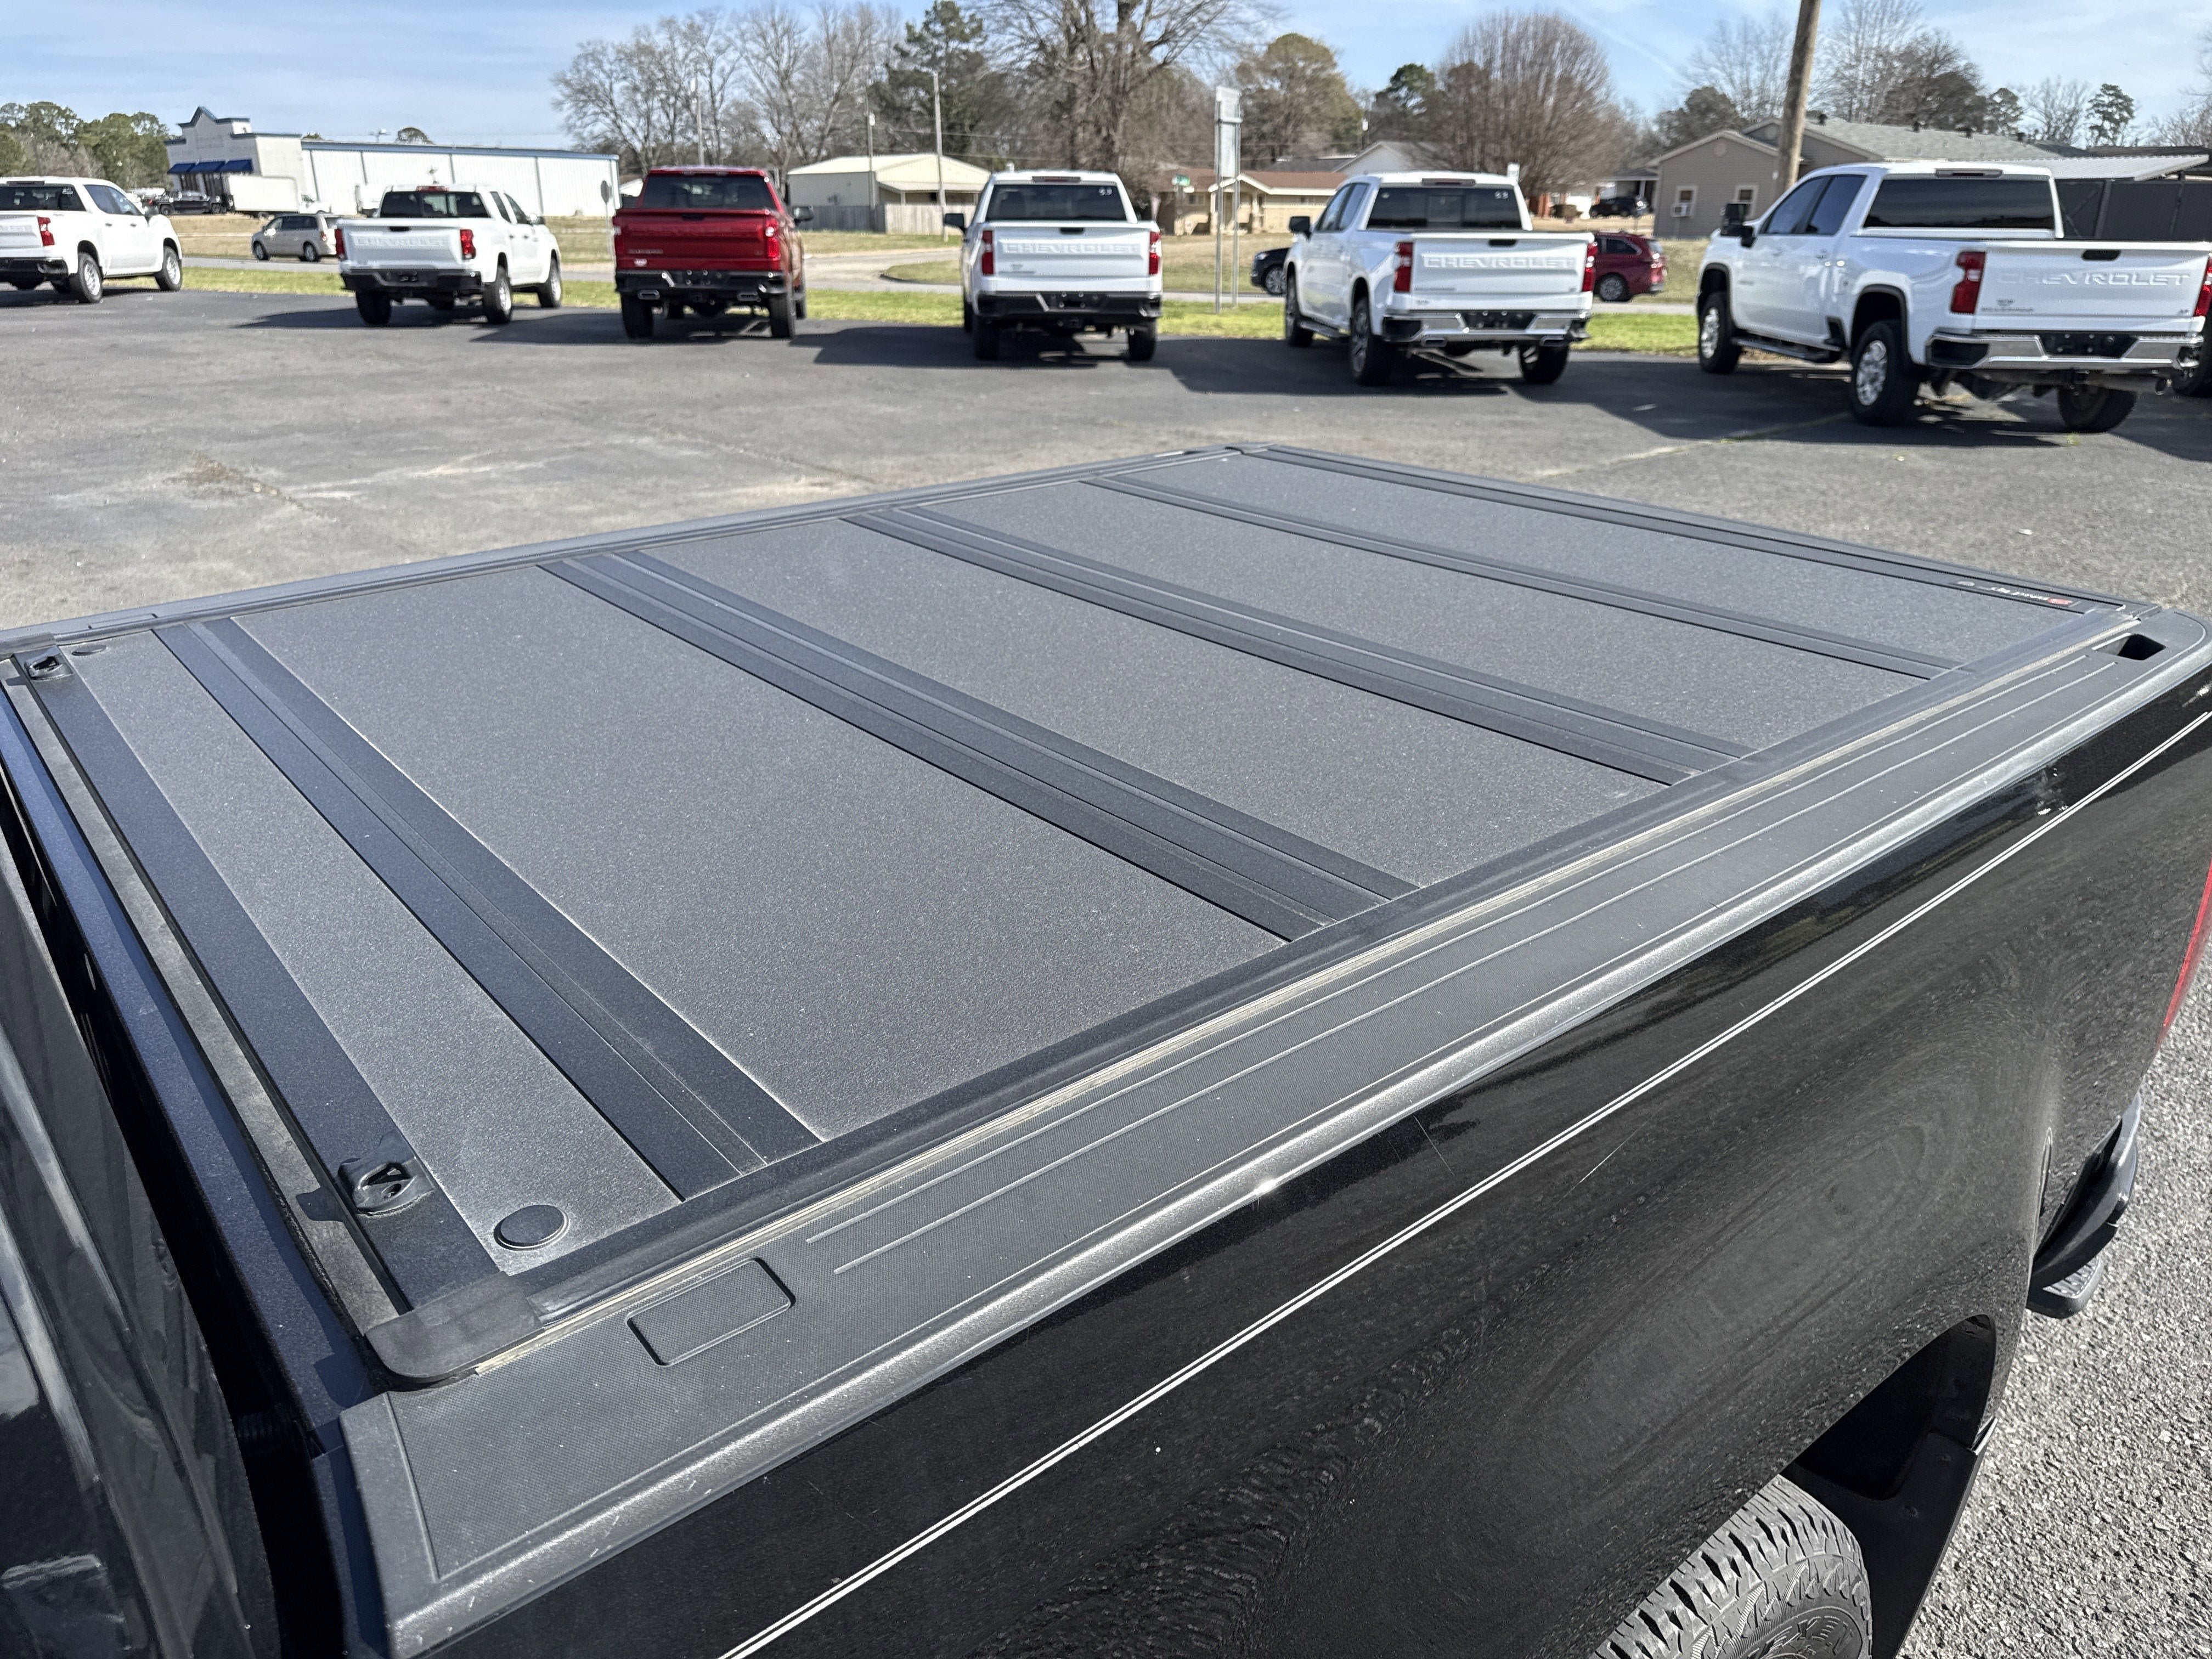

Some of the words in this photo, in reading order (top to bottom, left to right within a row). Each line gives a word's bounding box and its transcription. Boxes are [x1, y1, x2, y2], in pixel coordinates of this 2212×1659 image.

[1003, 243, 1142, 254] CHEVROLET
[1424, 256, 1577, 268] CHEVROLET
[1997, 274, 2190, 285] CHEVROLET
